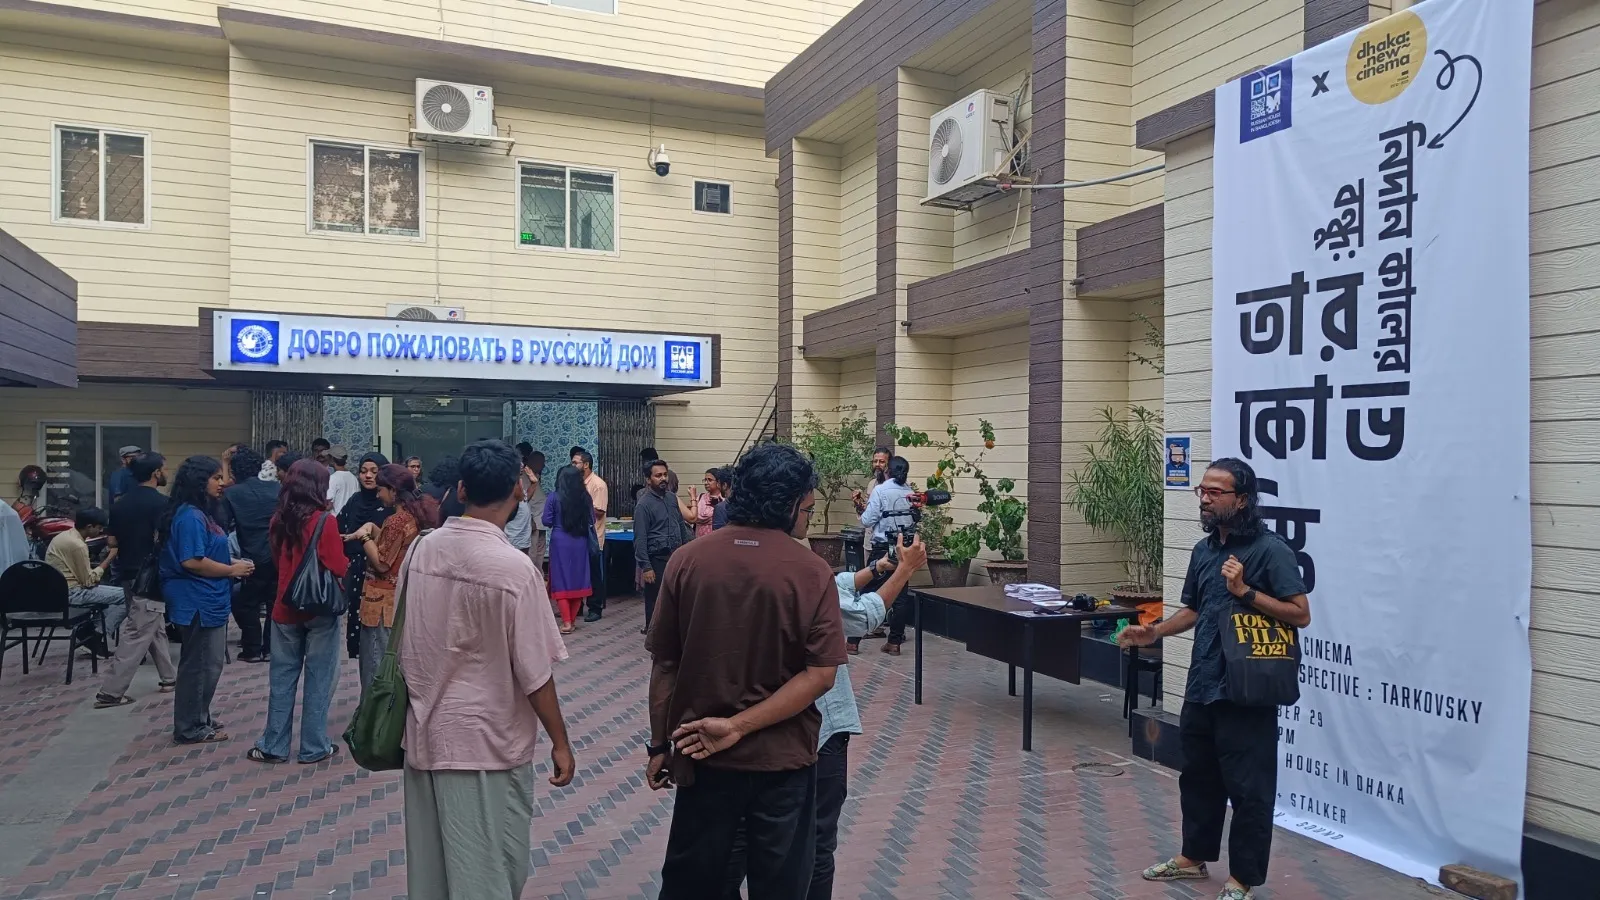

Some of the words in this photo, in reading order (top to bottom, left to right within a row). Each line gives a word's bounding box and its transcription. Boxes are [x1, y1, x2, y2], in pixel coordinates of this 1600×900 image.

[1356, 54, 1410, 81] cinema
[1378, 120, 1426, 241] নিদান
[1373, 247, 1416, 373] কালের
[288, 328, 361, 359] ДОБРО
[367, 332, 507, 363] ПОЖАЛОВАТЬ
[511, 338, 524, 363] В
[529, 337, 613, 368] РУССКИЙ
[616, 344, 657, 373] ДОМ
[1231, 613, 1292, 628] TOK
[1235, 627, 1295, 646] FILM
[1252, 644, 1287, 656] 2021
[1303, 636, 1353, 666] CINEMA
[1309, 709, 1323, 727] 29
[1381, 682, 1483, 724] TARKOVSKY
[1285, 752, 1329, 779] HOUSE
[1336, 767, 1349, 786] IN
[1356, 774, 1405, 805] DHAKA
[1290, 793, 1346, 824] STALKER
